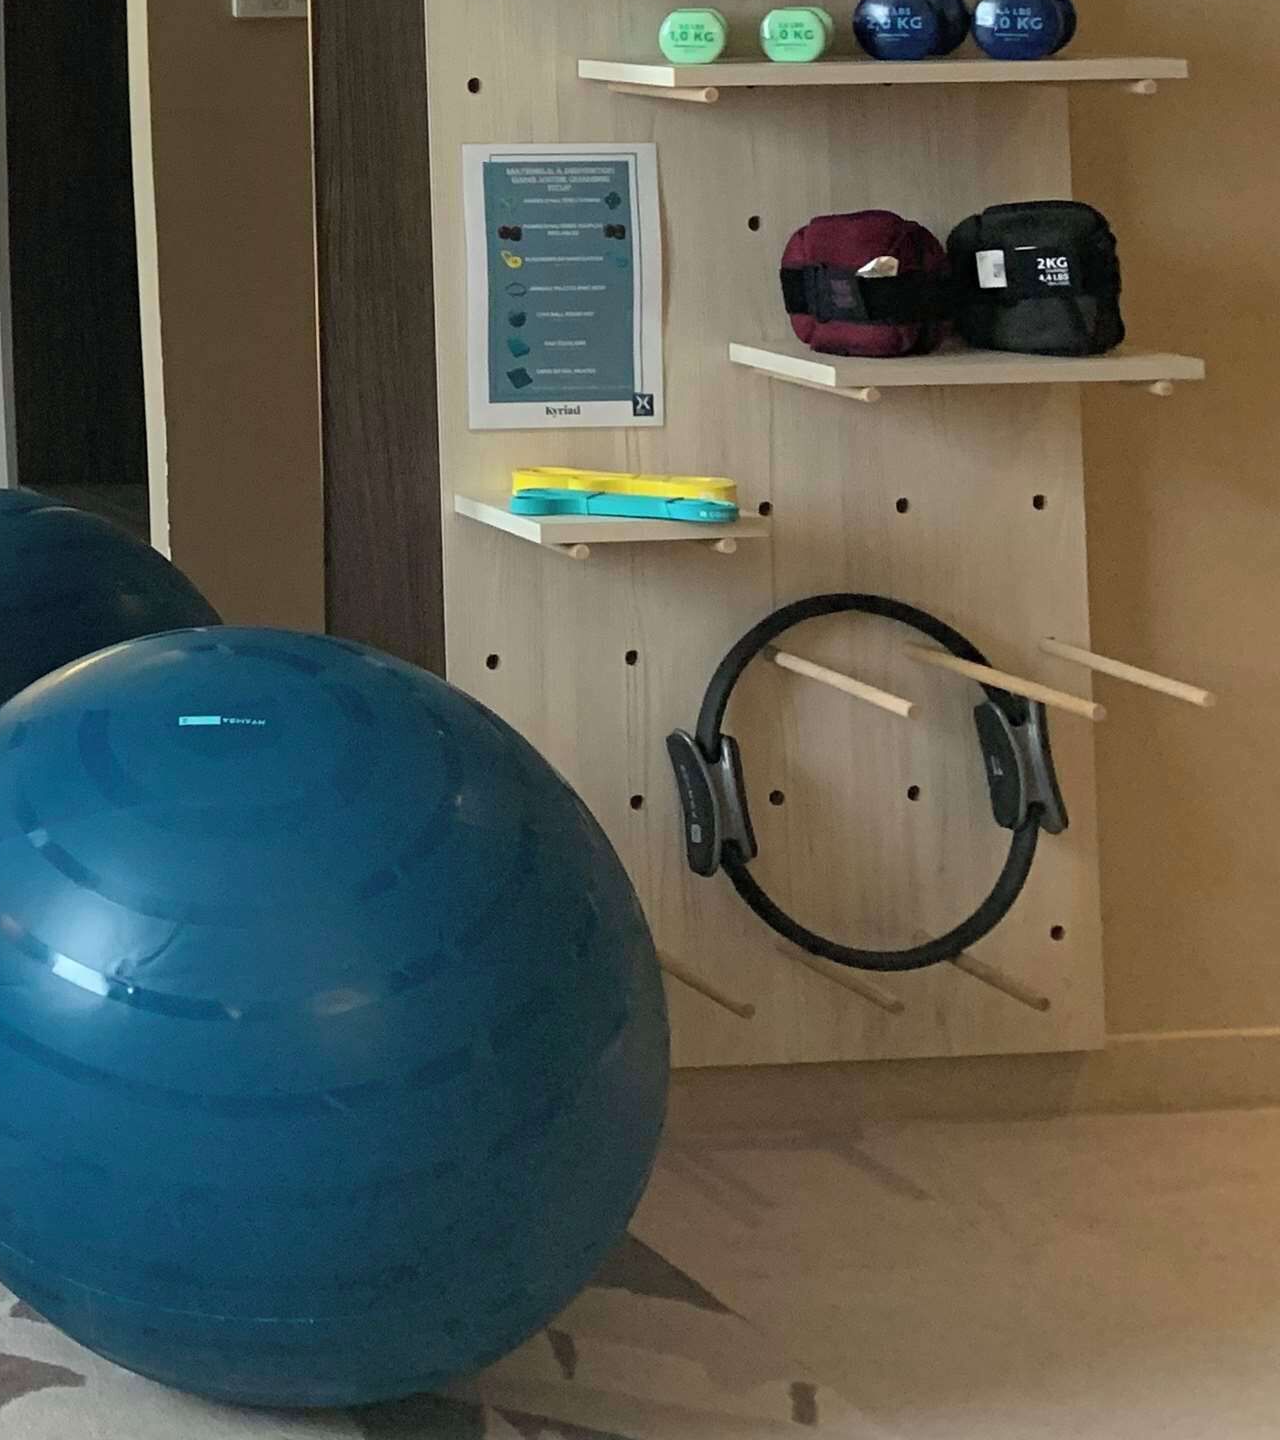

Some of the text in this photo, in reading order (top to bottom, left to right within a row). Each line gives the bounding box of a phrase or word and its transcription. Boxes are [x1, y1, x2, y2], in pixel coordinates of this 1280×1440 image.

[897, 16, 923, 30] KG
[1017, 17, 1044, 30] KG
[694, 31, 715, 42] KG
[793, 30, 815, 41] KG
[1037, 257, 1068, 269] 2KG
[1053, 273, 1070, 281] LBS
[545, 405, 581, 418] Kyriad
